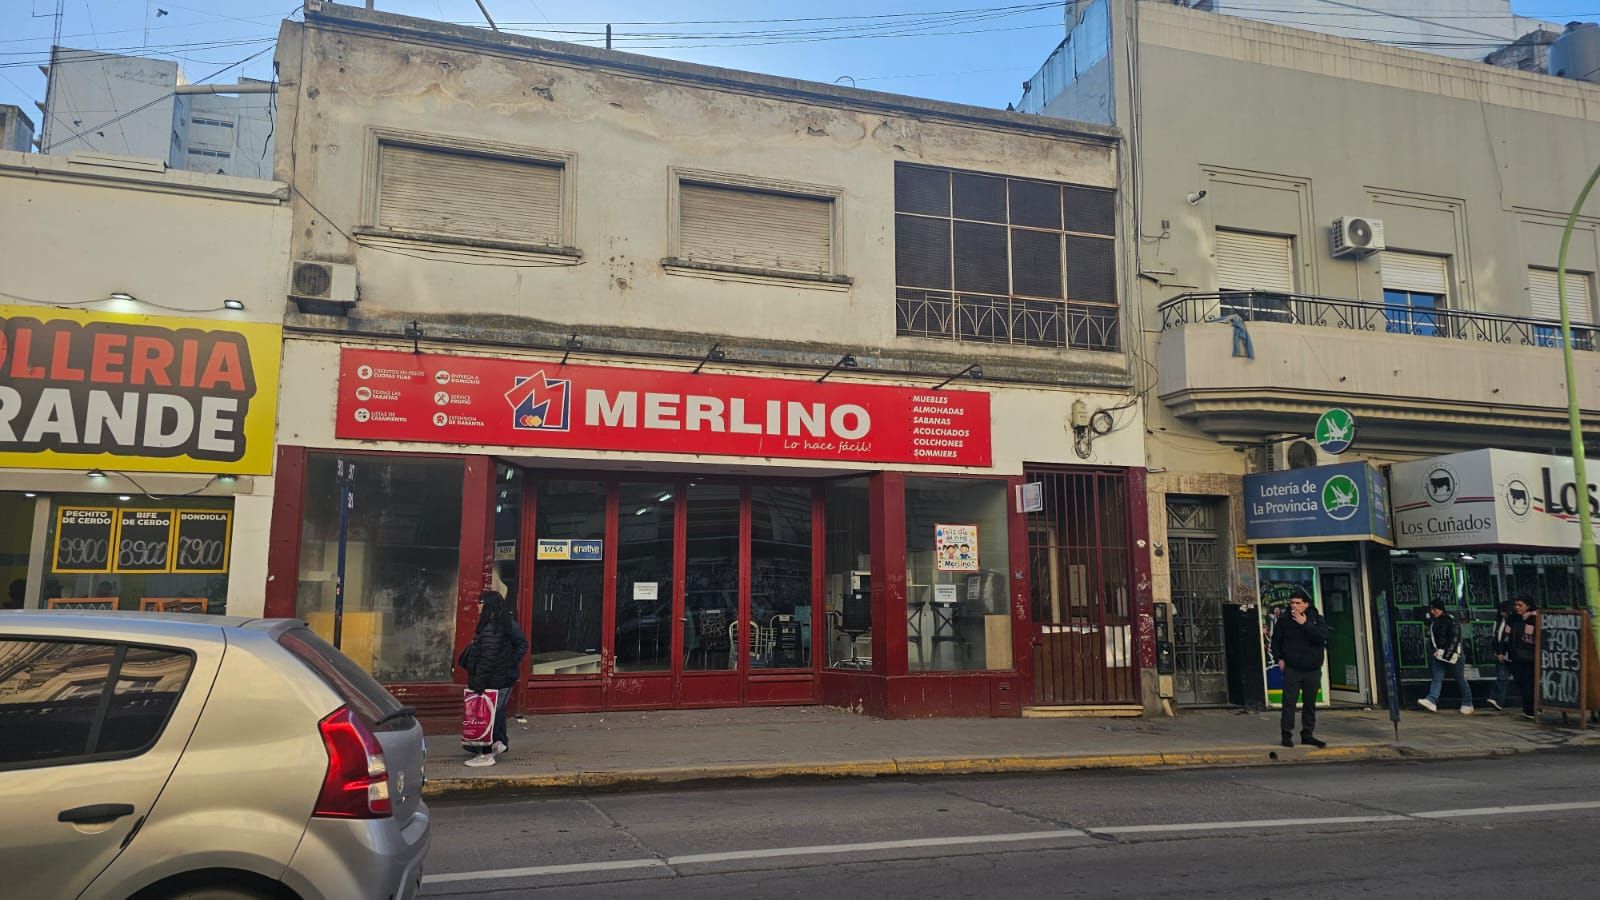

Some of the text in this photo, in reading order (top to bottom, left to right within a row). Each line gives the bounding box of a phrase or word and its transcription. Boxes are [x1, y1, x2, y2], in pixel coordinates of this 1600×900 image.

[0, 328, 246, 391] LLERIA
[912, 396, 948, 404] MUEBLES
[585, 389, 871, 439] MERLINO
[913, 406, 964, 415] ALMOHADAS
[913, 416, 951, 424] SABANAS
[913, 428, 970, 436] ACOLCHADOS
[784, 440, 872, 453] Lo hace fácil!
[914, 438, 964, 447] COLCHONES
[914, 450, 958, 458] SOMMIERS
[1260, 480, 1316, 497] Lotería de
[1254, 498, 1318, 516] la Provincia
[1401, 514, 1491, 534] Los Cuñados
[1541, 651, 1580, 670] BIFES
